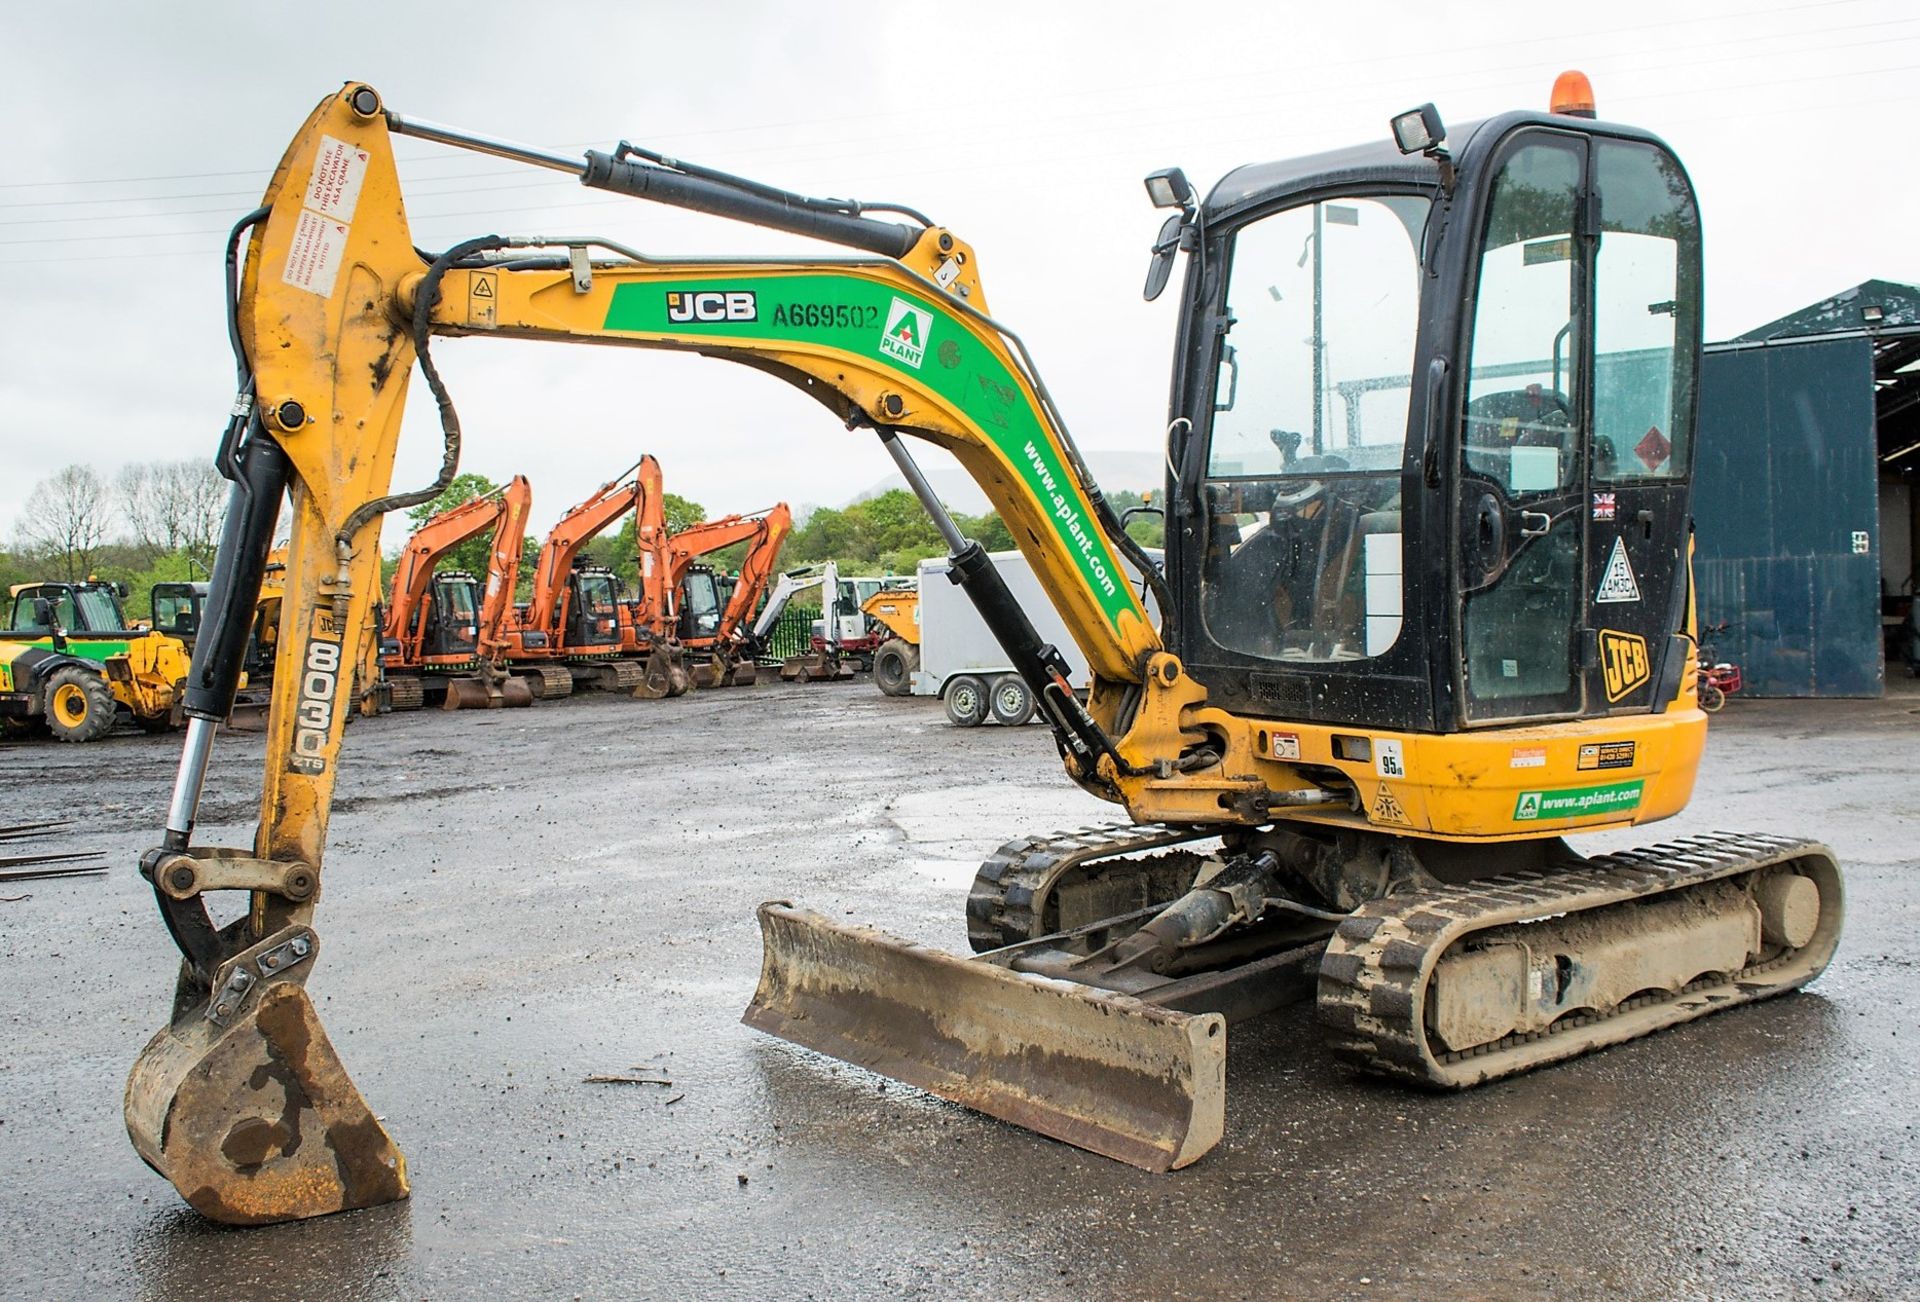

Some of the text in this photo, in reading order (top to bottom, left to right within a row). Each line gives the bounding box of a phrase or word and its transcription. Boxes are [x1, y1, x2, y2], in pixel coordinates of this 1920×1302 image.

[314, 150, 332, 199] DO NOT USE
[320, 144, 344, 212] THIS EXCAVATOR
[332, 193, 340, 205] AS
[338, 159, 350, 186] CRANE
[286, 269, 293, 279] DO
[294, 237, 303, 255] FULLY
[299, 213, 310, 236] CROWD
[304, 240, 312, 254] RAM
[304, 221, 326, 286] BREAKER ATTACHMENT
[320, 242, 330, 264] FITTED
[669, 293, 756, 321] JCB
[772, 303, 879, 329] A669502
[889, 310, 921, 348] A
[882, 338, 922, 363] PLANT
[1023, 440, 1116, 597] www.aplant.com
[1614, 562, 1625, 577] 15
[321, 617, 334, 632] JC
[1607, 637, 1645, 694] JCB
[296, 641, 340, 758] 8030
[293, 757, 324, 769] ZTS
[1382, 755, 1397, 775] 95
[1542, 789, 1640, 809] www.aplant.com
